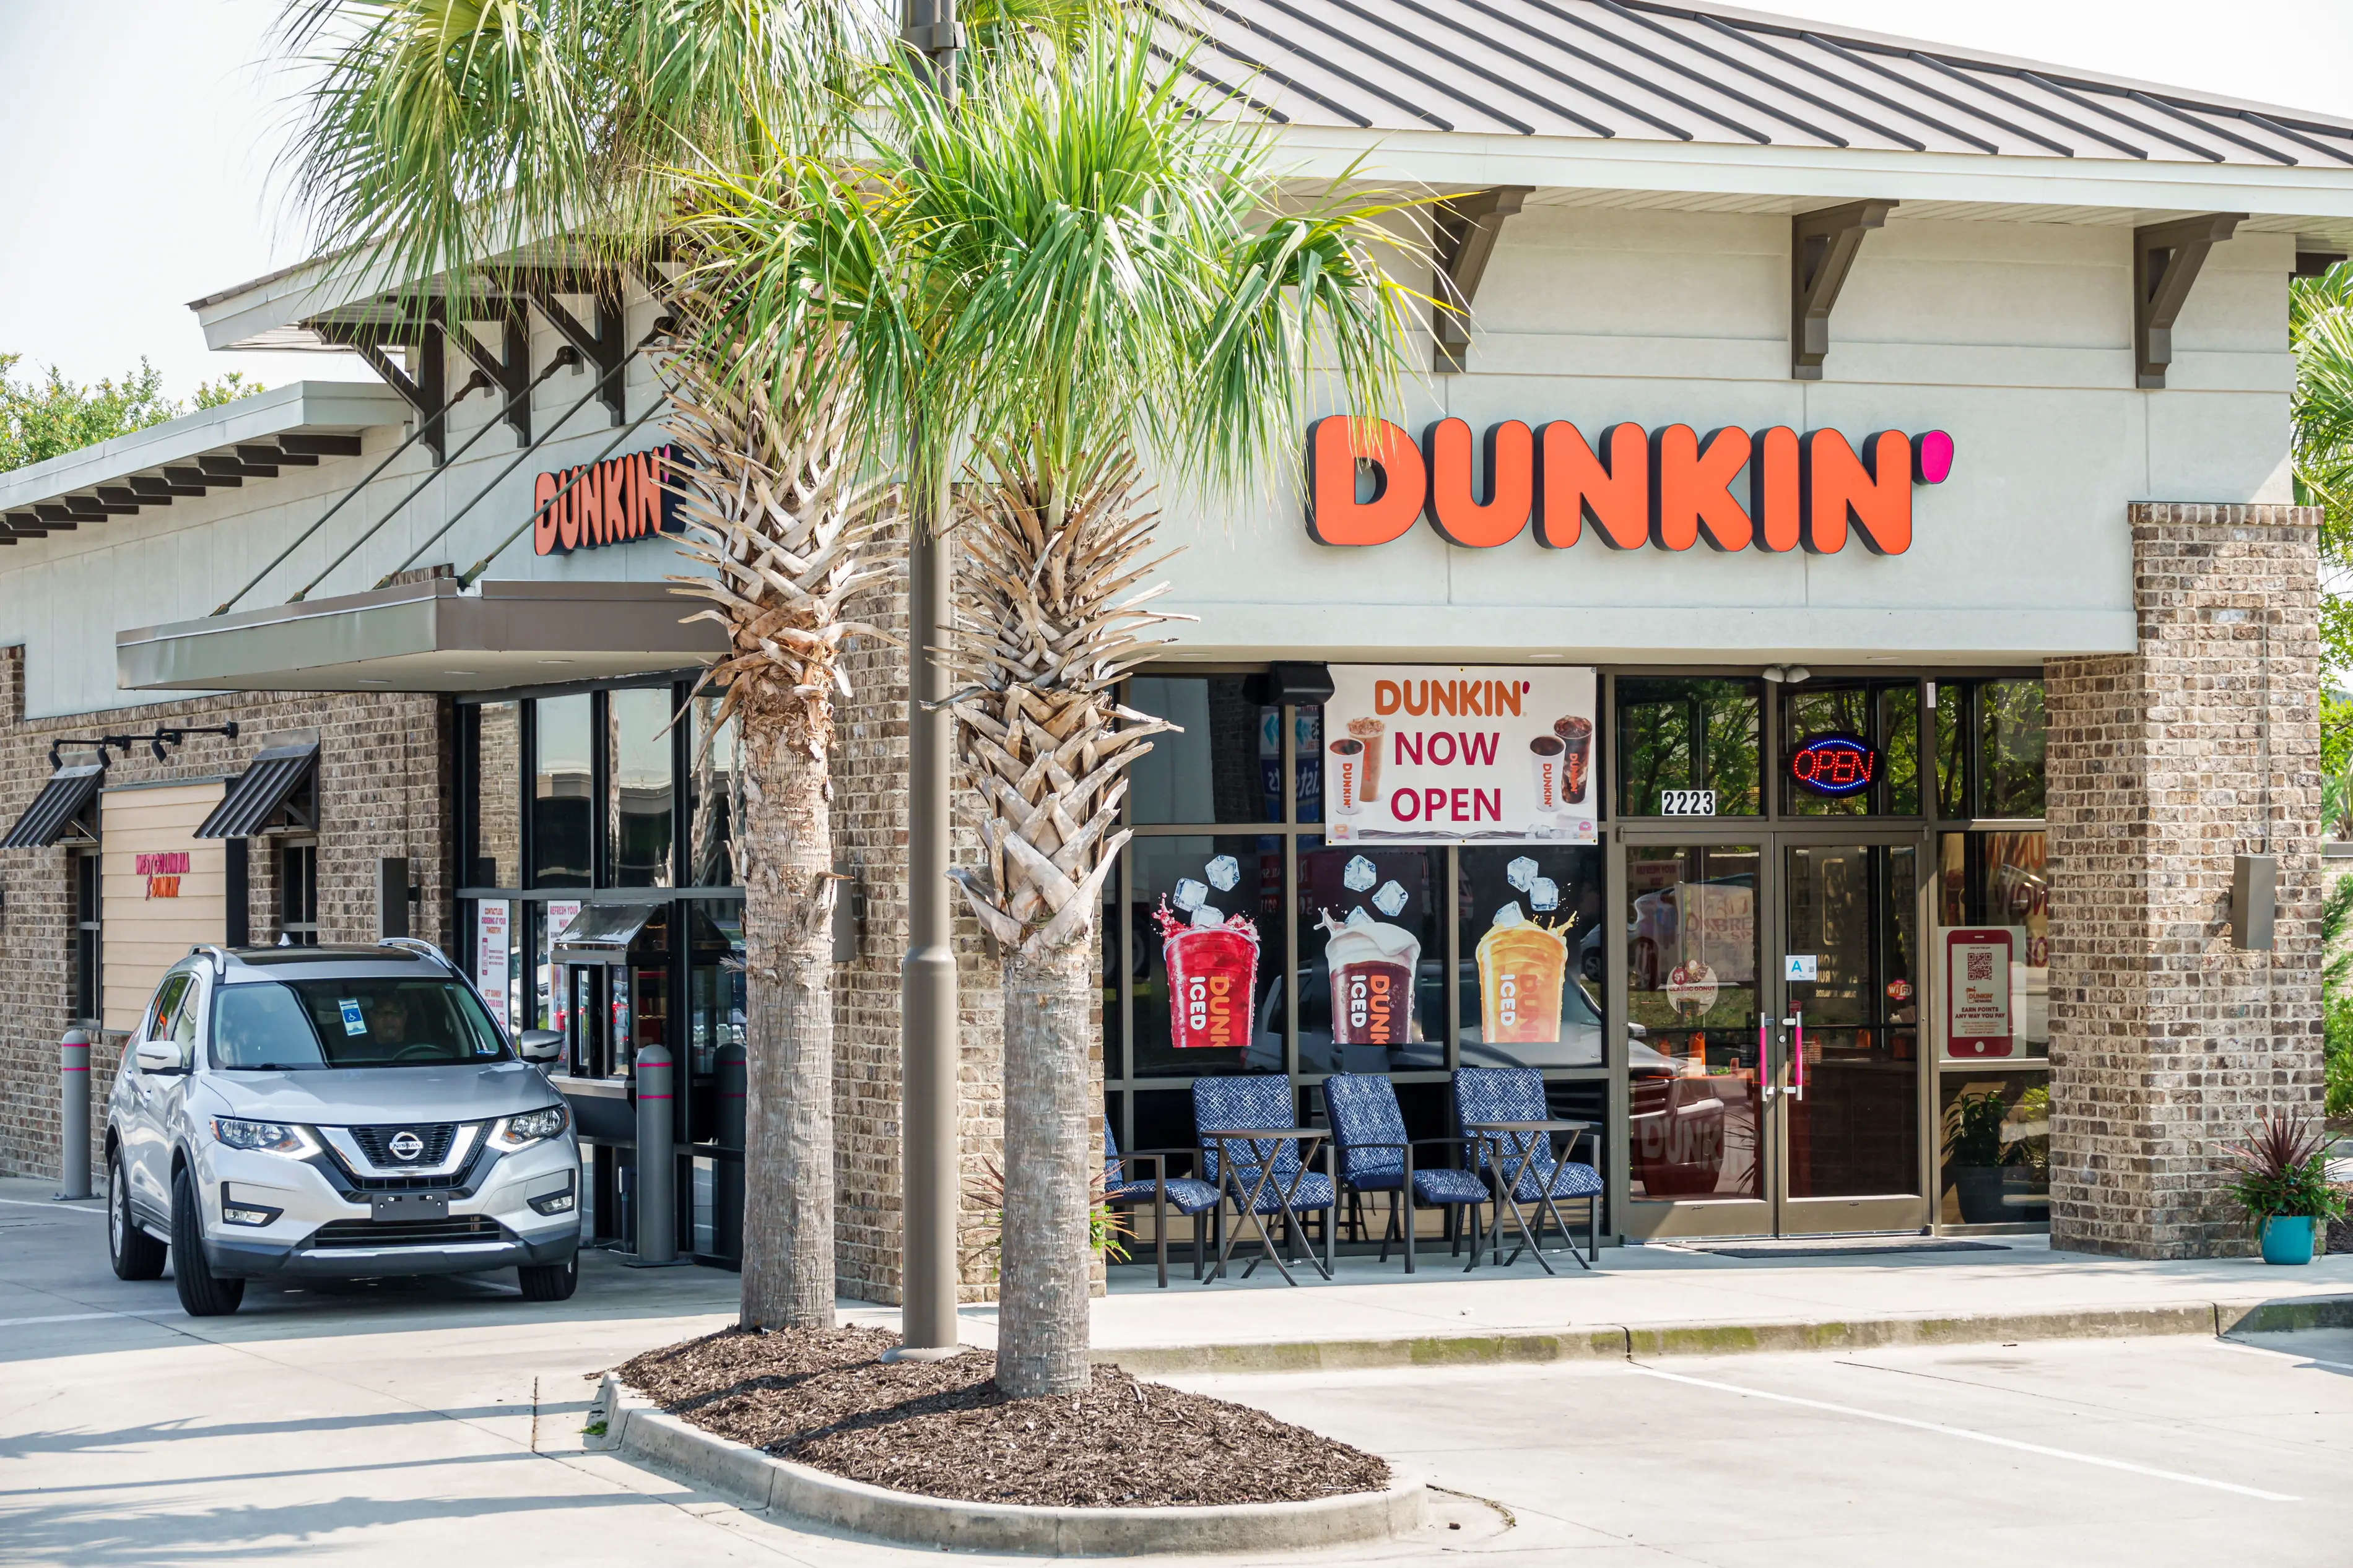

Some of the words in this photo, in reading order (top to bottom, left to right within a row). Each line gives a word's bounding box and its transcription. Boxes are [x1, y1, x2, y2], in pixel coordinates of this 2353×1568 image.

[534, 444, 672, 556] DUNKIN'
[1305, 414, 1954, 556] DUNKIN'
[1375, 679, 1530, 717] DUNKIN'
[1395, 731, 1500, 766] NOW
[1794, 750, 1873, 782] OPEN
[1342, 763, 1352, 808] DUNKIN'
[1543, 763, 1552, 807] DUNKIN'
[1569, 753, 1578, 794] DUNKIN'
[1391, 787, 1501, 822] OPEN
[1664, 791, 1713, 814] 2223
[550, 906, 567, 915] REFRESH
[568, 906, 578, 915] YOUR
[1674, 971, 1684, 982] $1
[1791, 960, 1803, 972] A
[1190, 976, 1206, 1030] ICED
[1350, 975, 1367, 1028] ICED
[1500, 974, 1516, 1026] ICED
